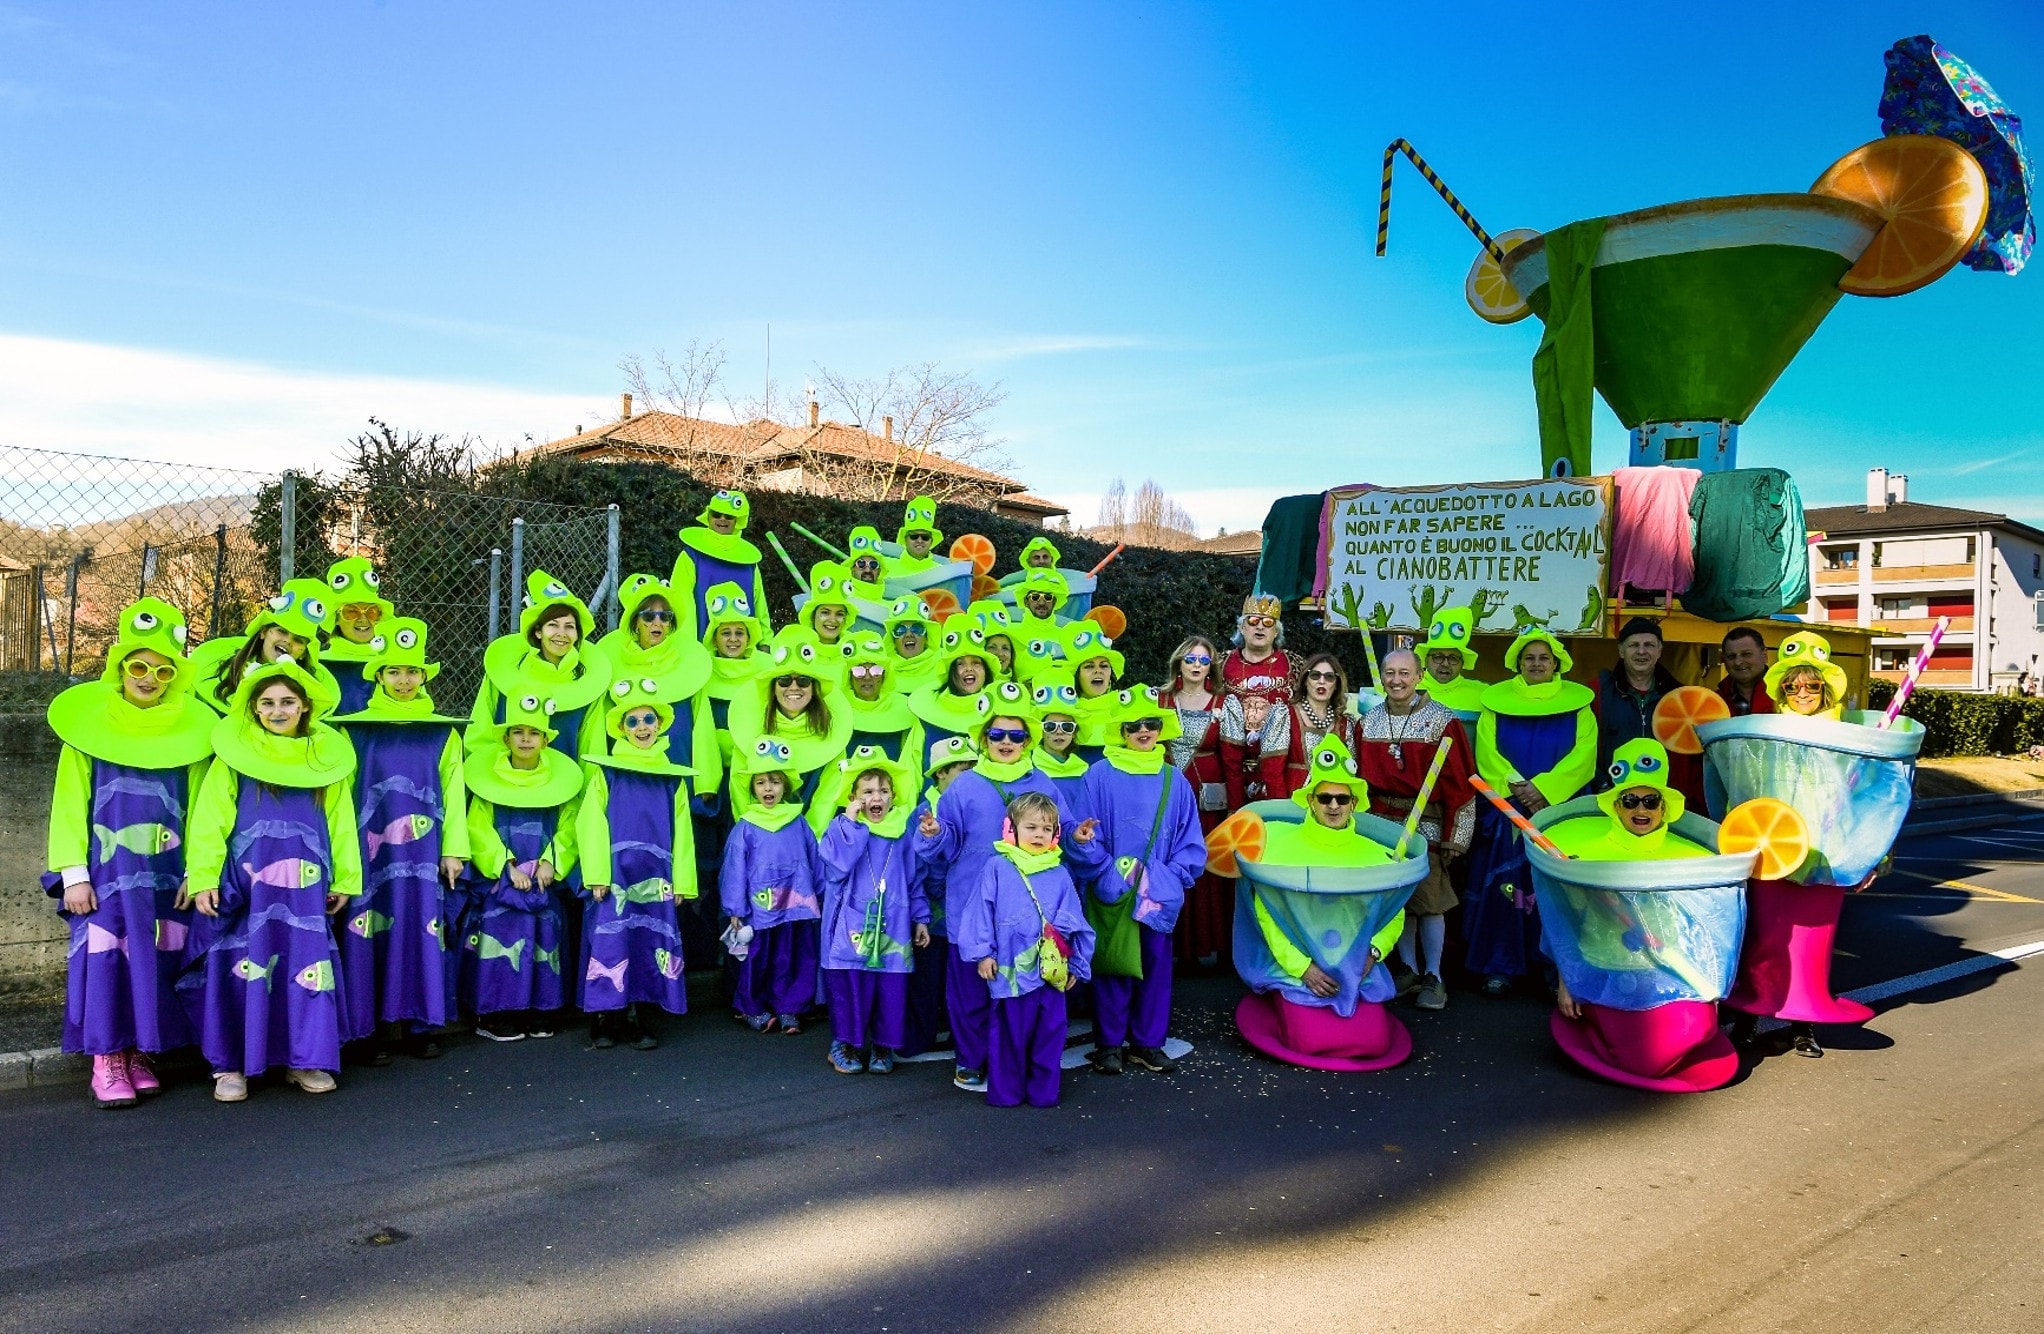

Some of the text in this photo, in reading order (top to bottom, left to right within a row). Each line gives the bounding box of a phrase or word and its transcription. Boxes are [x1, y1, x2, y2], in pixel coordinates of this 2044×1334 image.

[1521, 492, 1535, 508] A
[1538, 489, 1597, 508] LAGO
[1345, 521, 1381, 537] NON
[1384, 517, 1422, 535] FAR
[1426, 513, 1506, 534] SAPERE
[1345, 523, 1605, 560] QUANTO È BUONO IL COCKTAIL
[1344, 555, 1542, 582] AL CIANOBATTERE
